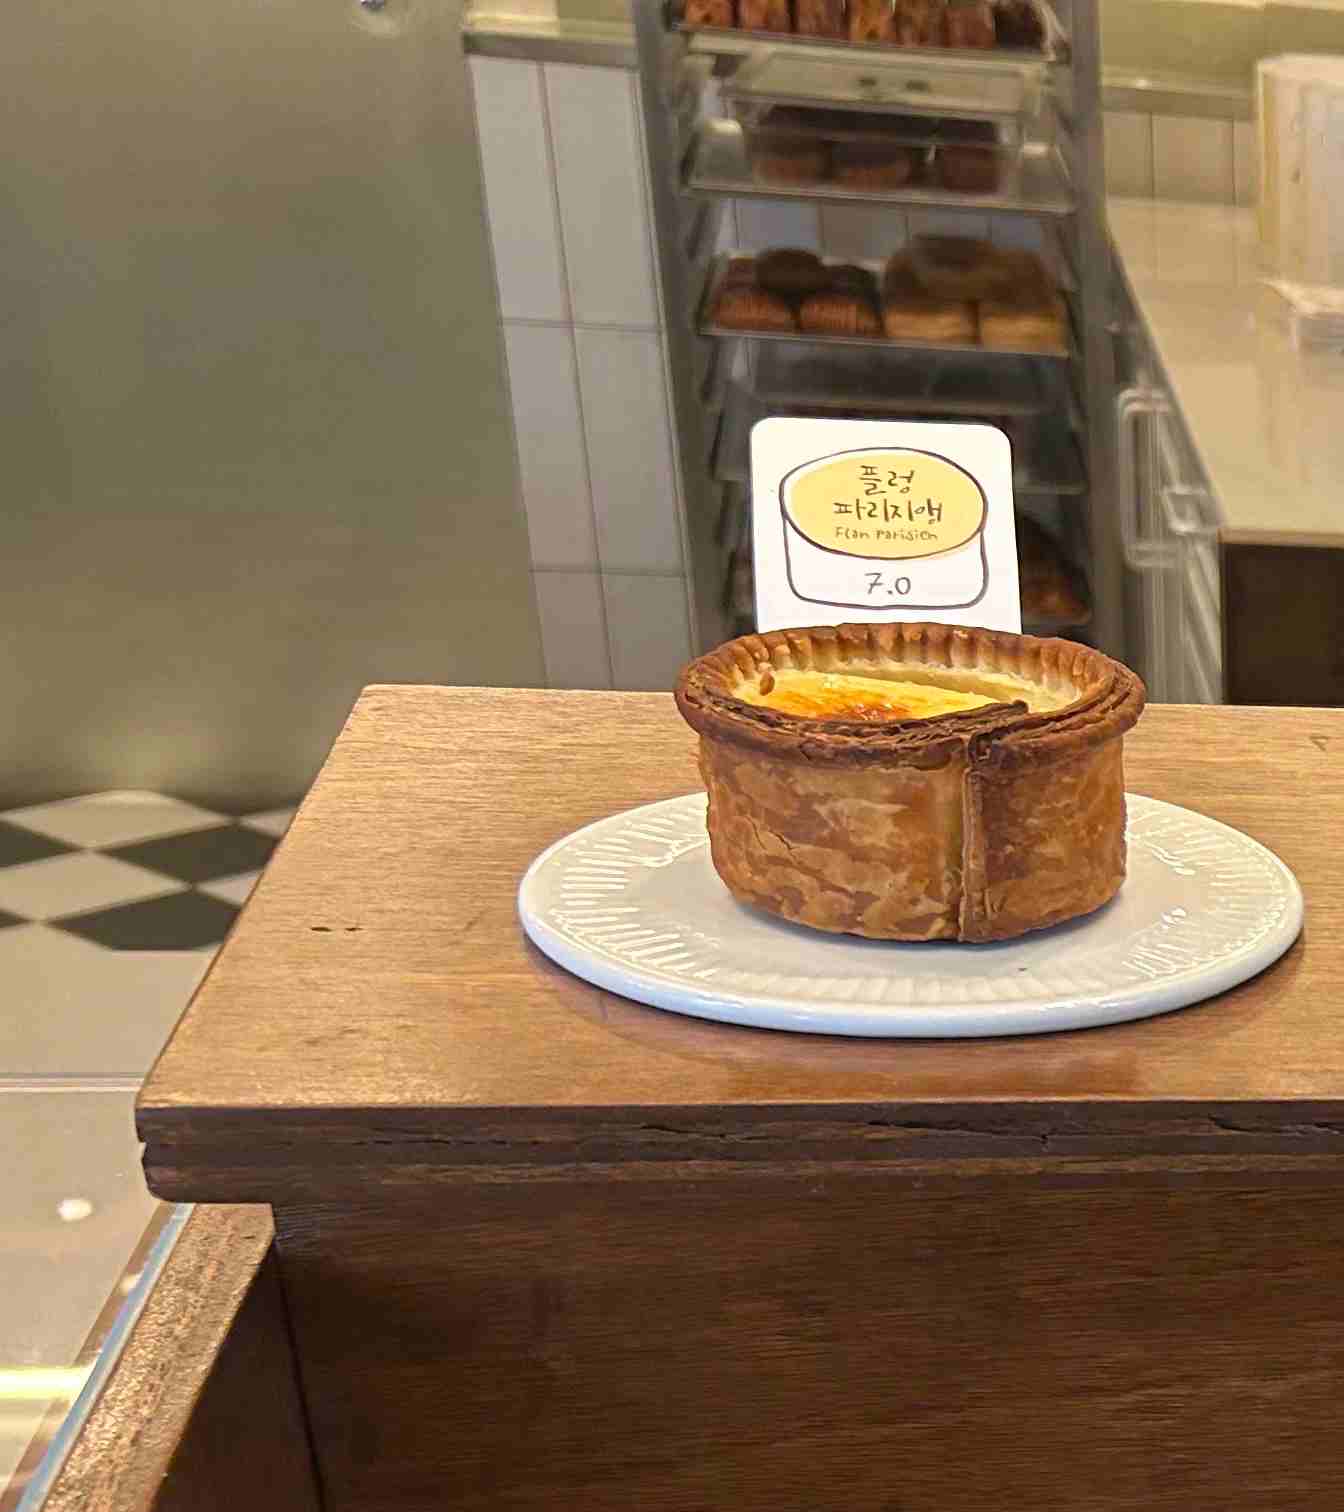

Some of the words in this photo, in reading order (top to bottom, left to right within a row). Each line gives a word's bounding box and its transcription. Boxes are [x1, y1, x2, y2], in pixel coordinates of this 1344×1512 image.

[859, 464, 916, 496] 플렁
[833, 498, 943, 525] 파리지앵
[834, 525, 870, 540] Flan
[863, 572, 912, 597] 7.0
